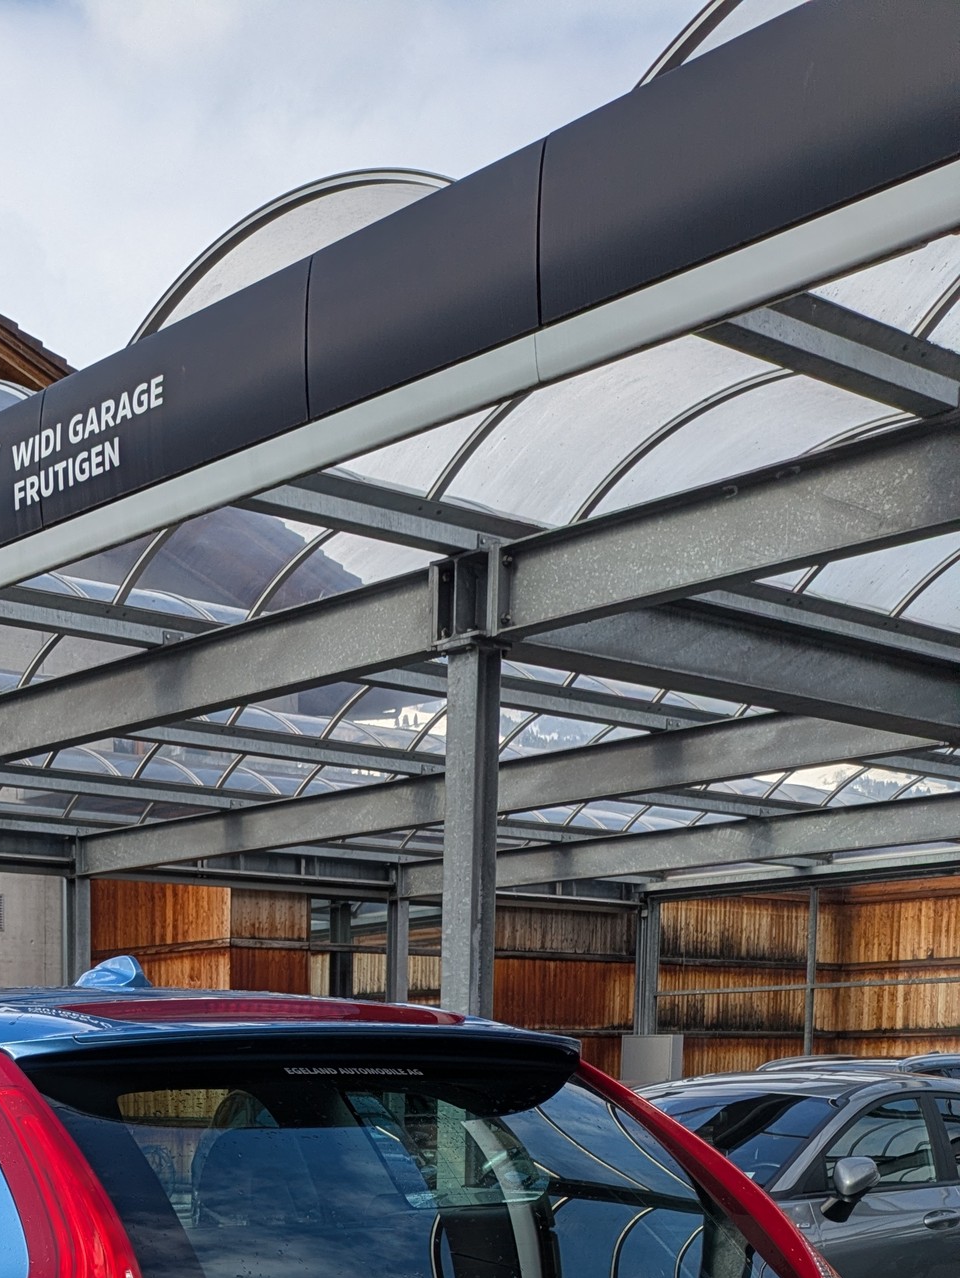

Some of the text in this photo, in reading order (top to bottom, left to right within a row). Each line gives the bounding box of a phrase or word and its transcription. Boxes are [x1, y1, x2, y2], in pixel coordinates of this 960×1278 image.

[11, 374, 164, 472] WIDI GARAGE
[13, 436, 120, 511] FRUTIGEN
[283, 1067, 425, 1076] EGELAND AUTOMOBILE AG
